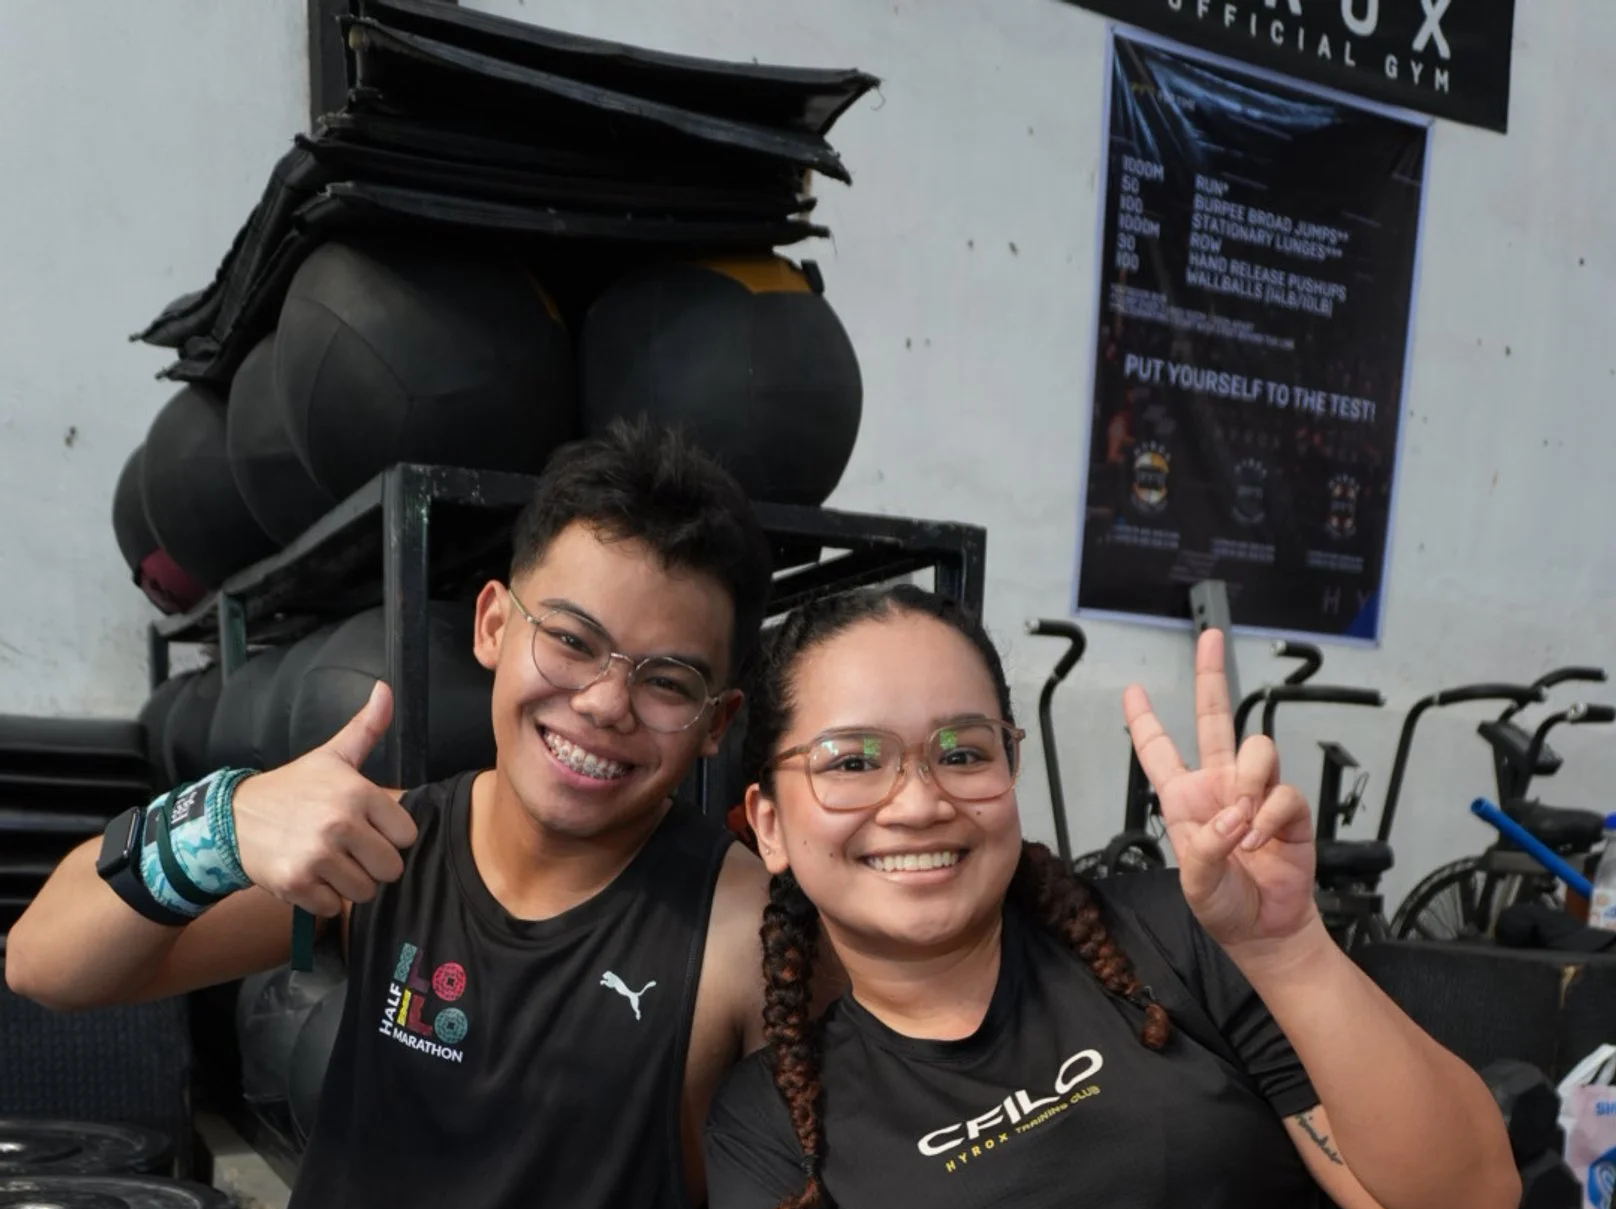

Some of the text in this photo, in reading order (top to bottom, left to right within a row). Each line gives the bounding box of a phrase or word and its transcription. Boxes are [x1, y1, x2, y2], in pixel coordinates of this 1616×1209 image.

[1384, 53, 1450, 94] GYM
[1122, 154, 1165, 181] 1000M
[1118, 213, 1222, 254] 1000M ROW
[1119, 192, 1143, 214] 100
[1191, 212, 1275, 247] STATIONARY
[1193, 193, 1246, 221] BURPEE
[1248, 207, 1293, 234] BROAD
[1115, 250, 1140, 273] 100
[1186, 267, 1263, 300] WALLBALLS
[1188, 250, 1228, 273] HAND
[1229, 258, 1285, 286] RELEASE
[1287, 272, 1347, 303] PUSHUPS
[1124, 353, 1377, 423] PUT YOURSELF TO THE TEST!
[379, 983, 402, 1036] HALF
[392, 1027, 464, 1064] MARATHON
[917, 1049, 1104, 1157] CFILO
[945, 1085, 1101, 1172] HYROX TRAINING CLUB
